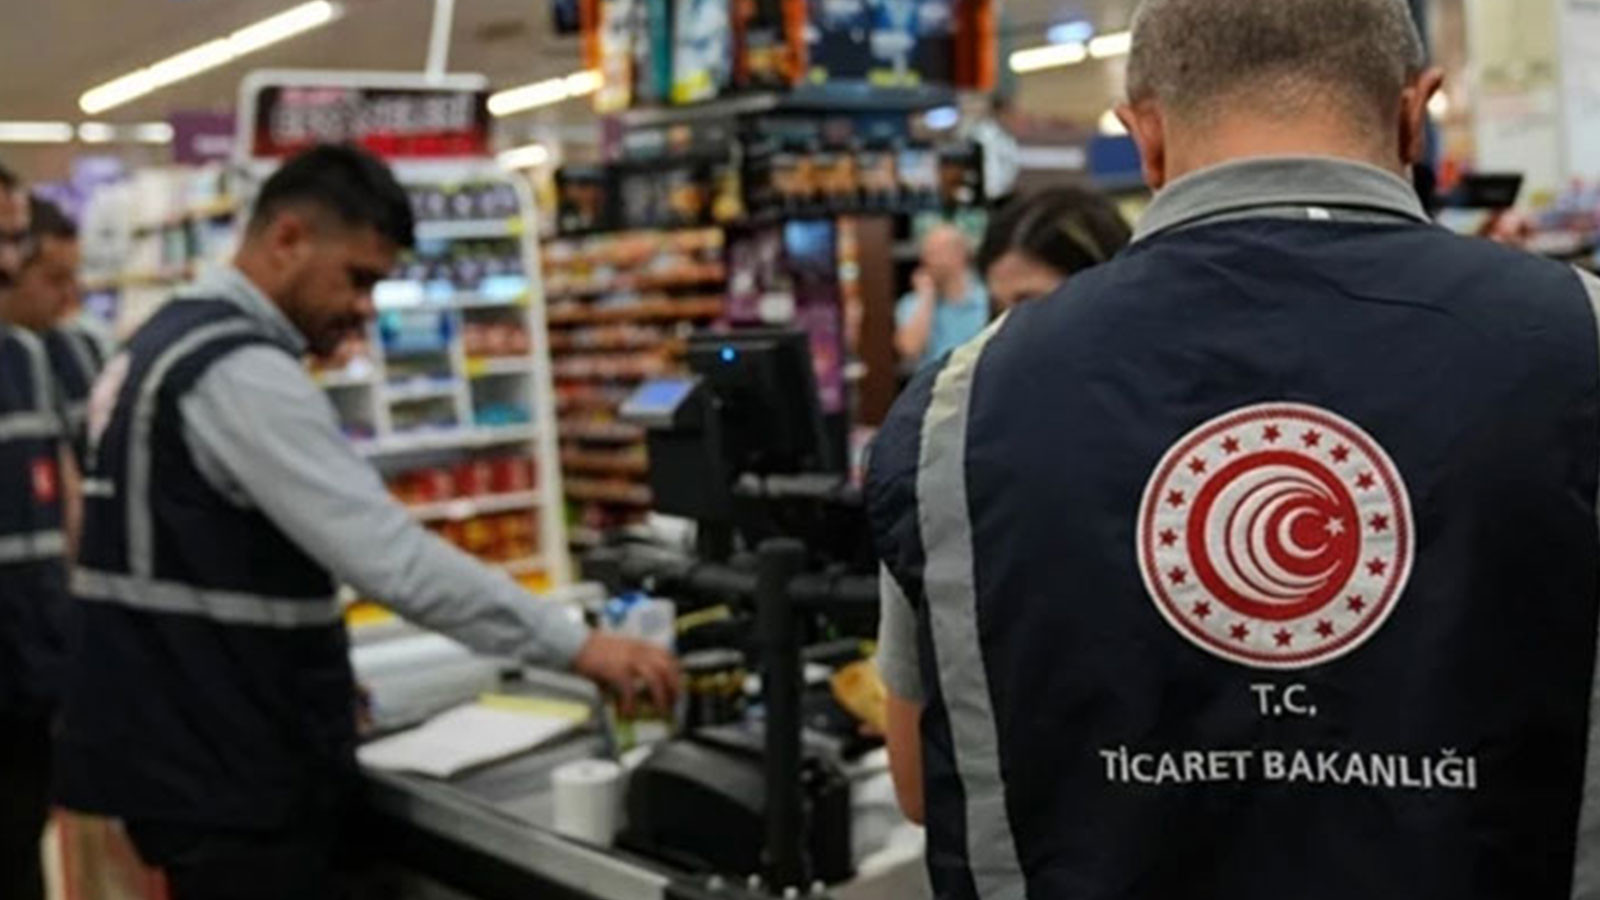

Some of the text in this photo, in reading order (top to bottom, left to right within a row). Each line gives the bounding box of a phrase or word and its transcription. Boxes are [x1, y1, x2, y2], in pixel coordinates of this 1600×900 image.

[1251, 683, 1317, 716] T.C.
[1100, 745, 1477, 789] TİCARET BAKANLIĞI
